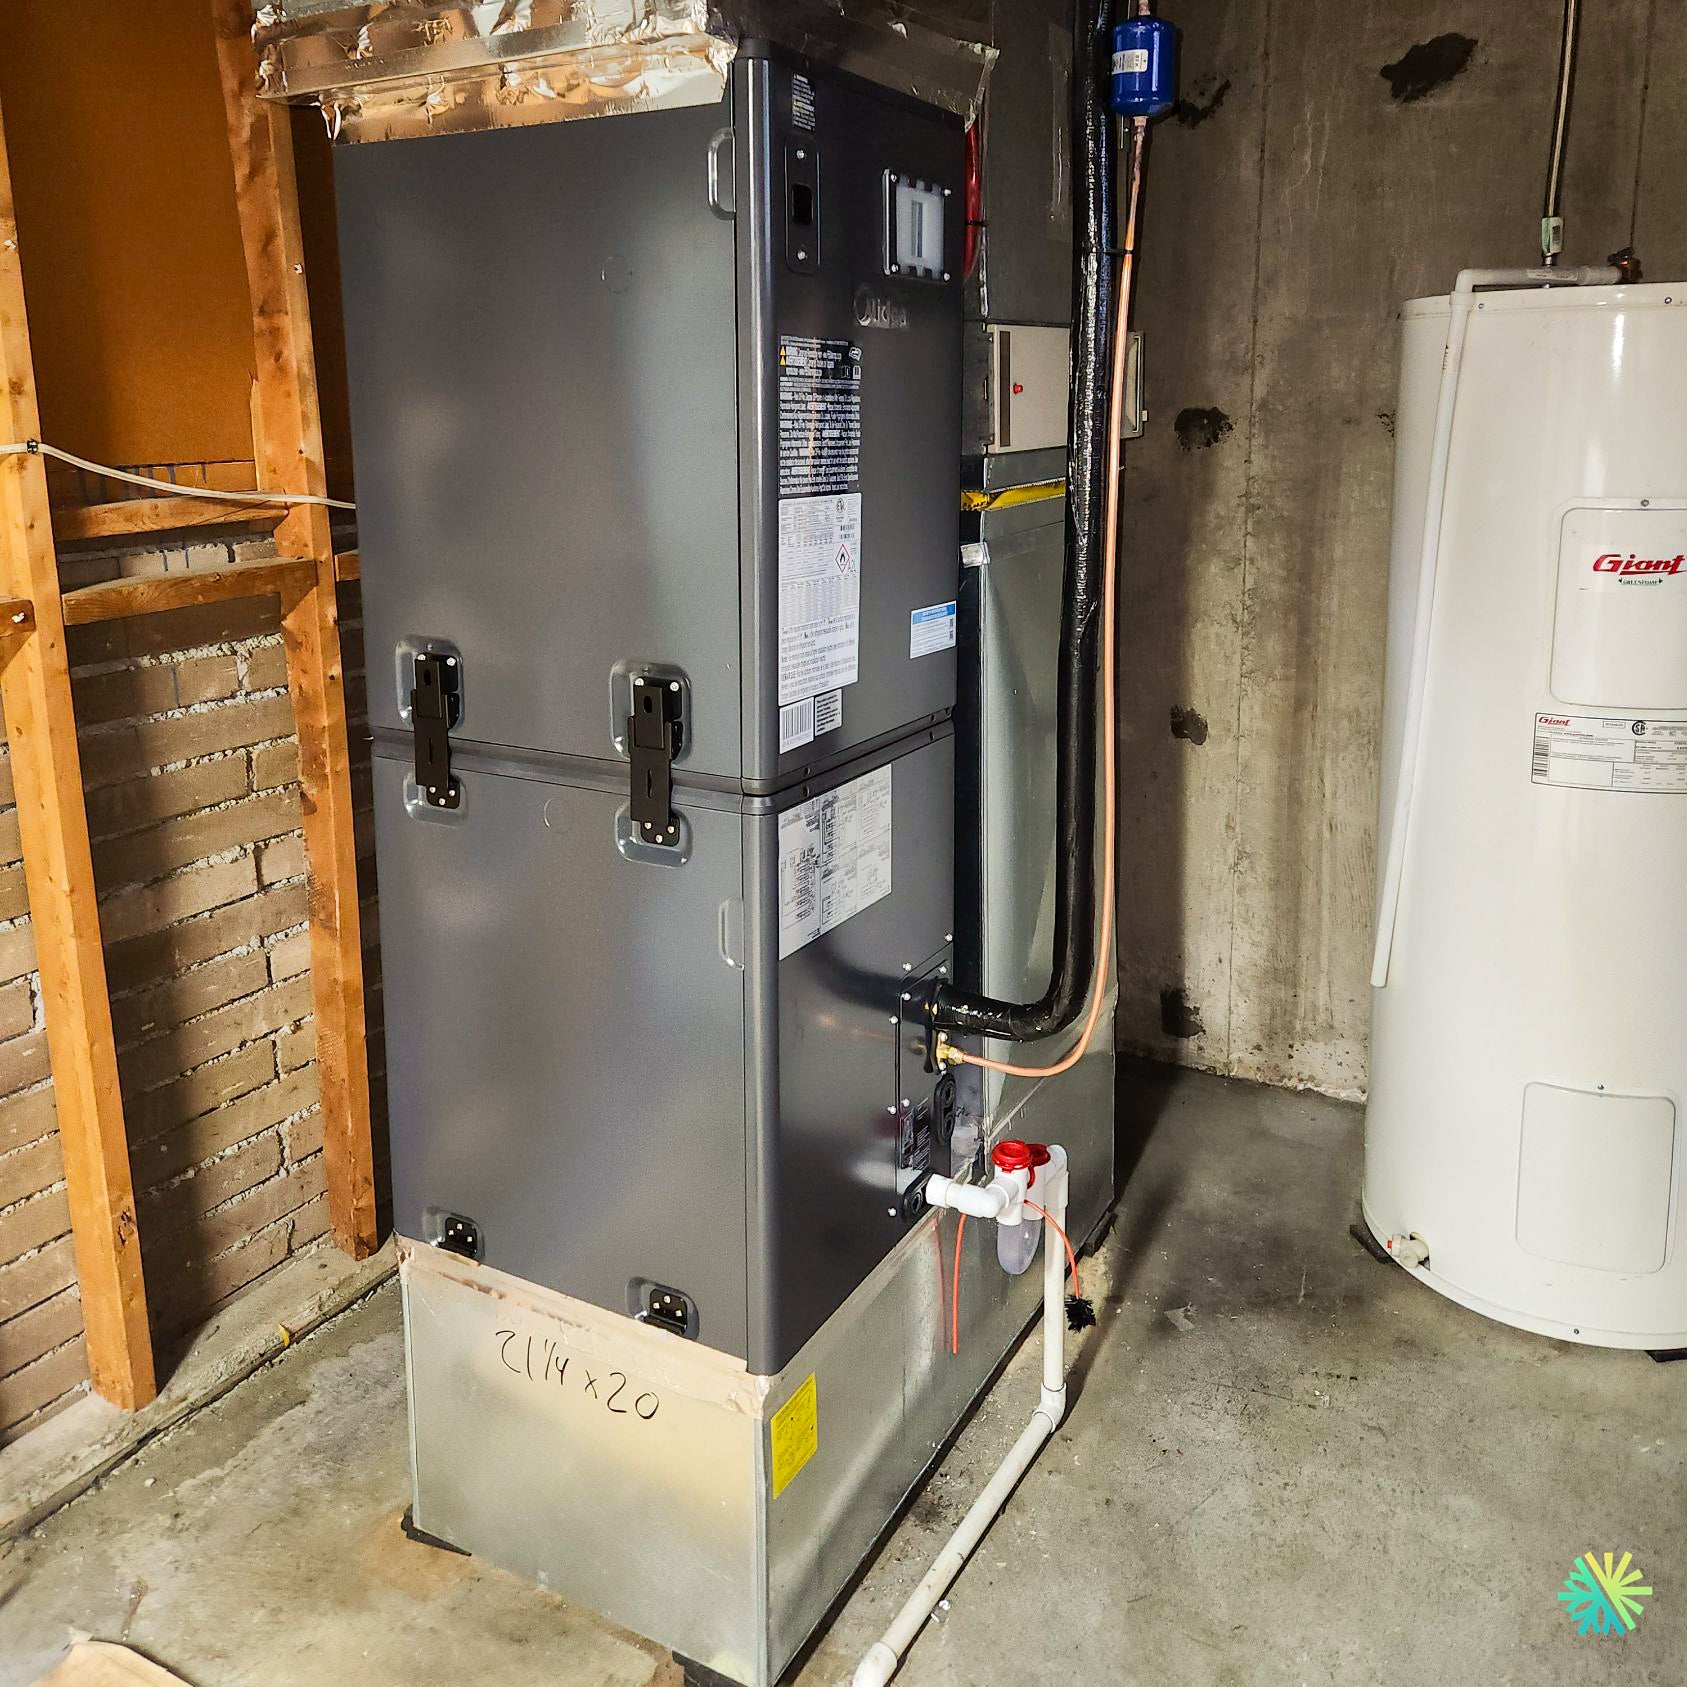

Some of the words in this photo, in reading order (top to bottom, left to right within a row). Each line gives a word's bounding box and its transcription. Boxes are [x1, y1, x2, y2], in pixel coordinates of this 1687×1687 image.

[1592, 553, 1687, 575] Giant
[1538, 715, 1570, 727] Giant
[584, 1370, 599, 1400] x
[607, 1372, 660, 1420] 20
